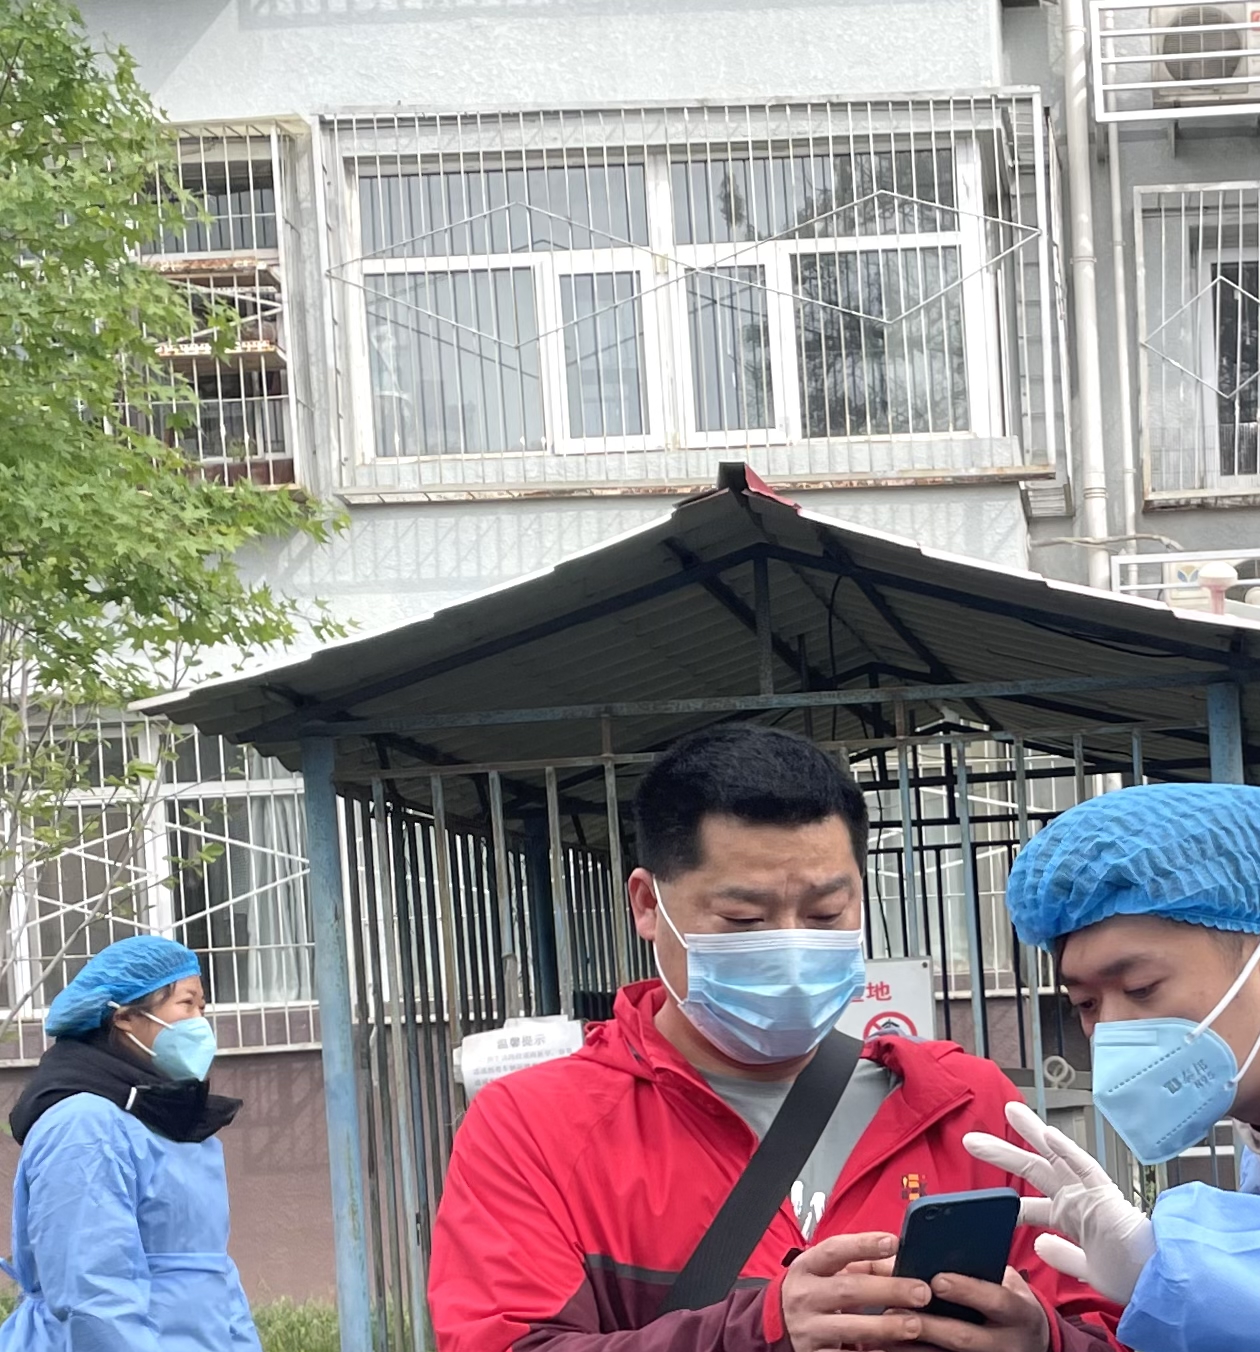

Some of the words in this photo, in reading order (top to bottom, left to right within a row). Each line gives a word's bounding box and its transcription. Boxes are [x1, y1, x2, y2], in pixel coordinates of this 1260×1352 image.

[851, 981, 892, 1003] 地
[497, 1034, 546, 1049] 温馨提示
[1193, 1071, 1216, 1089] N95
